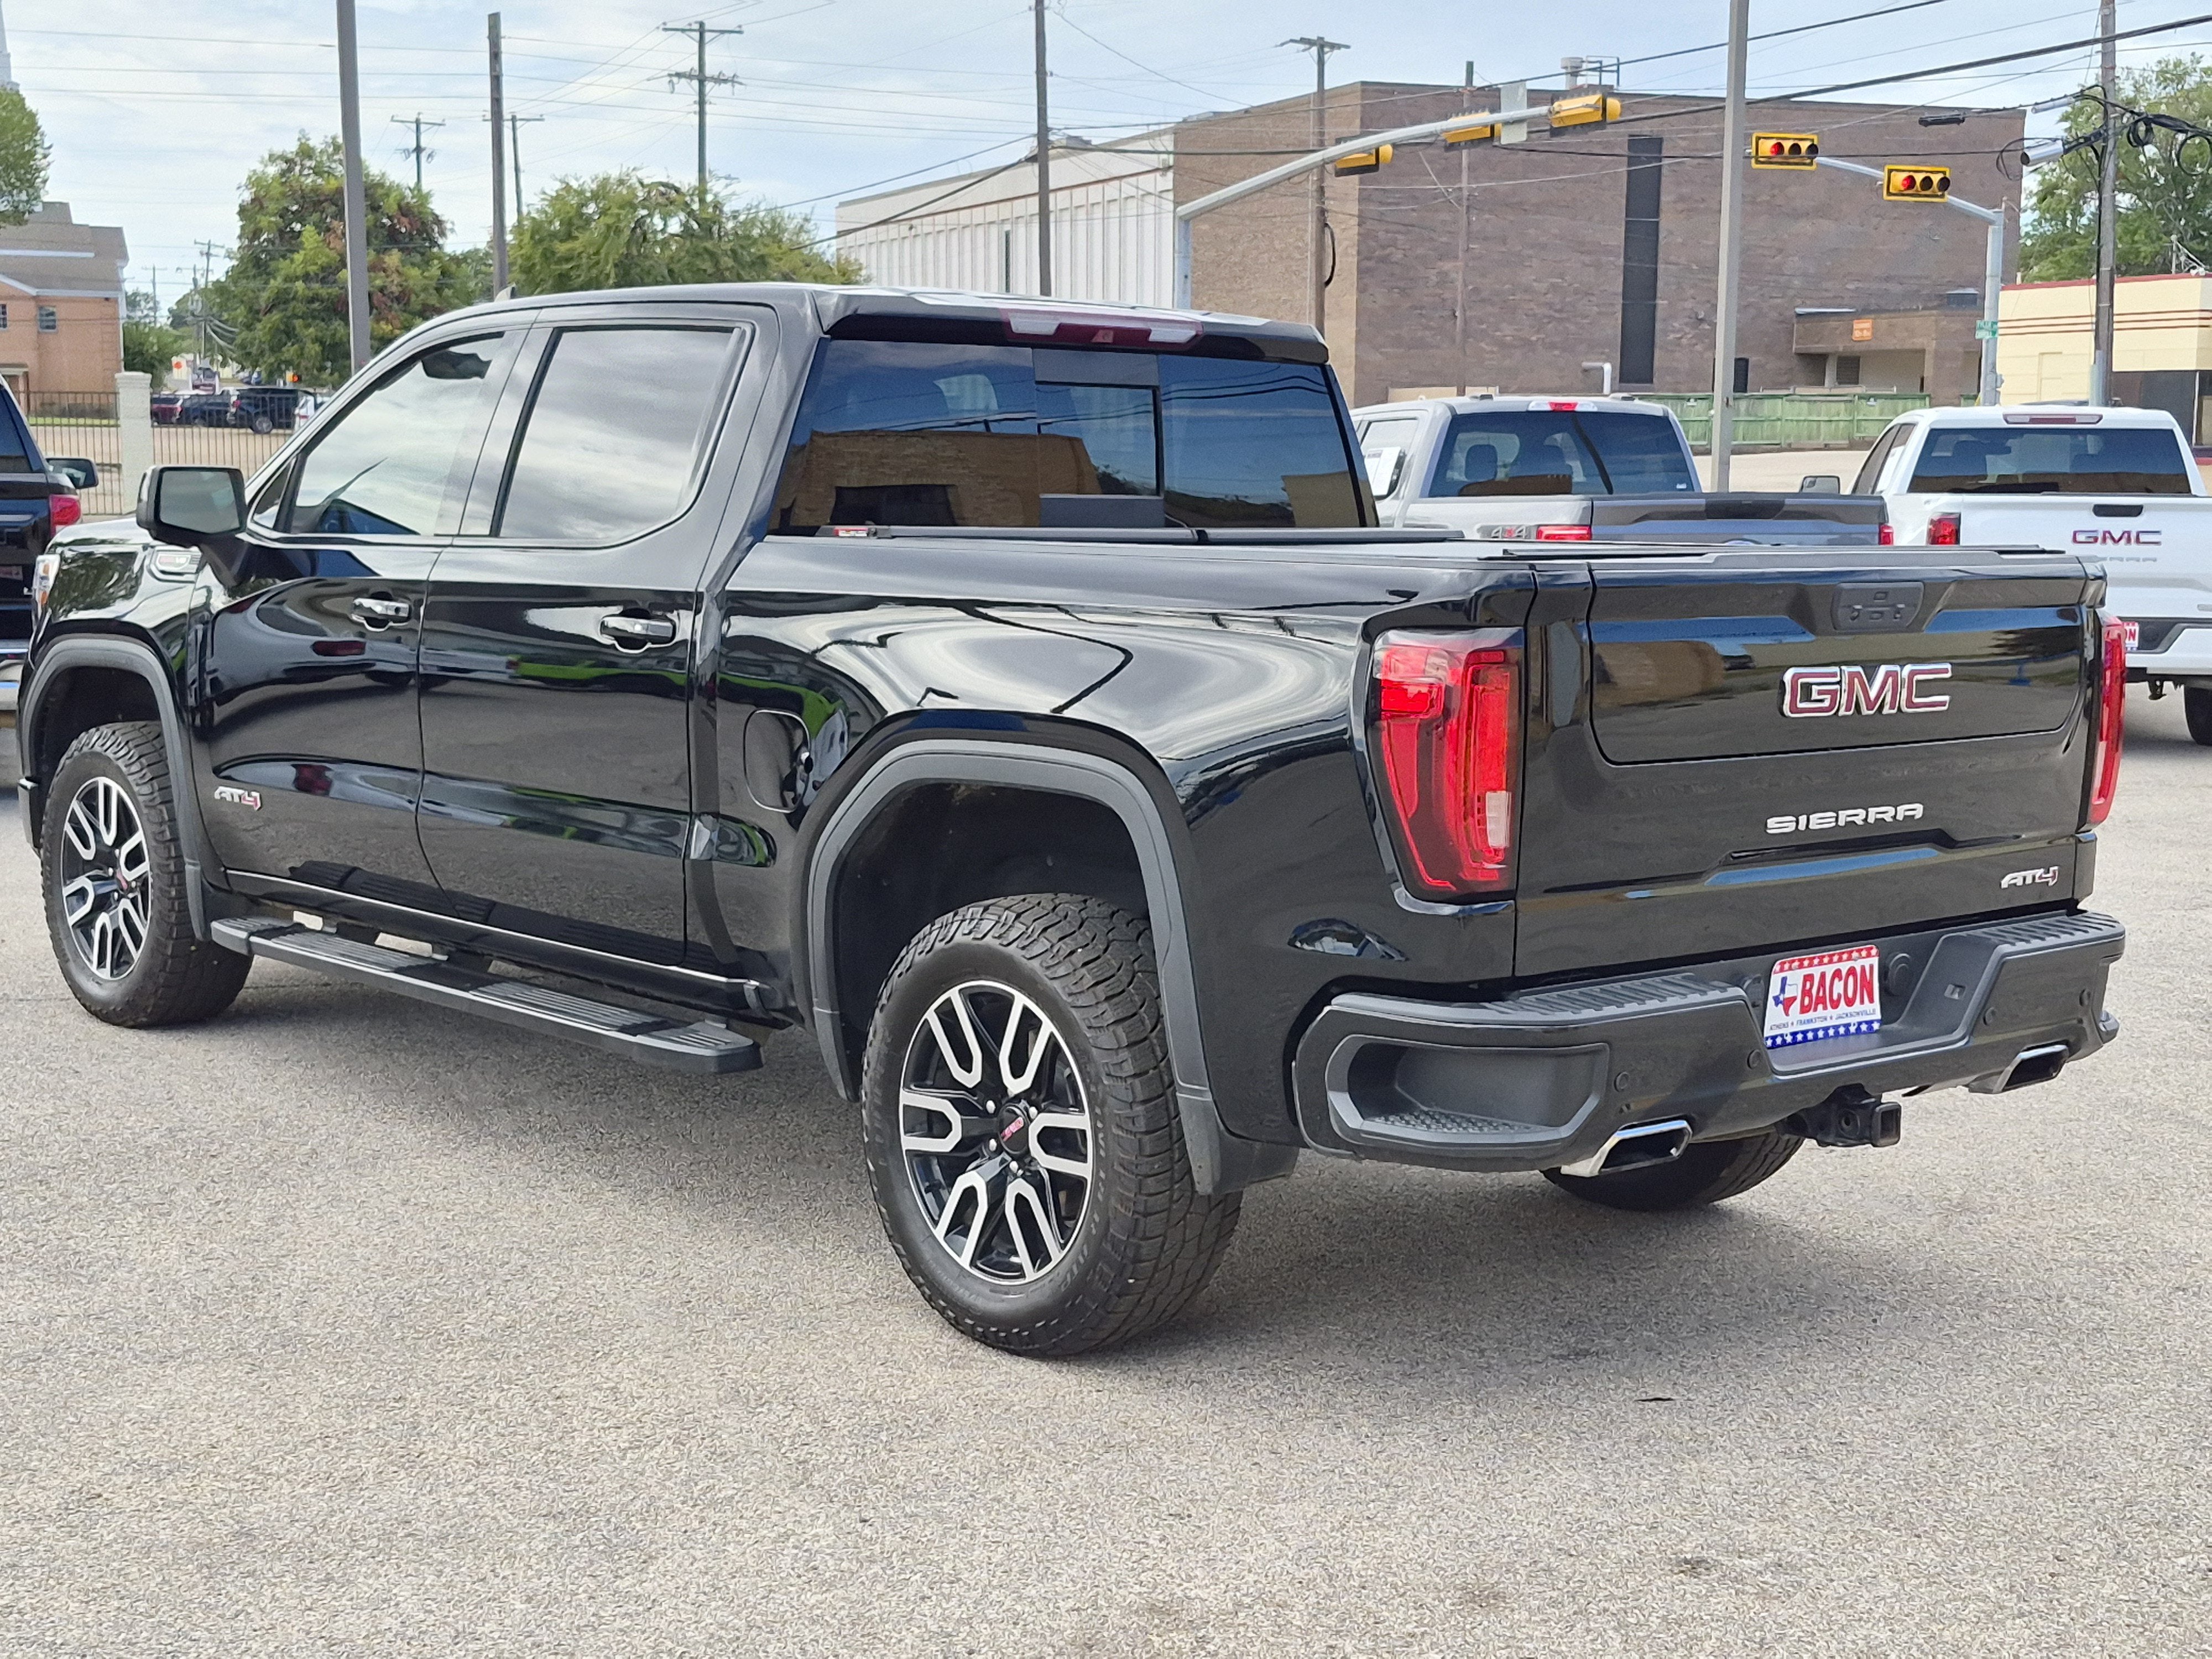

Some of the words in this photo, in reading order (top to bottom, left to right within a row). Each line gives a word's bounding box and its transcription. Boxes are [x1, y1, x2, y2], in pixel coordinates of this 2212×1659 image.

[2072, 530, 2162, 545] GMC
[1782, 662, 1952, 717] GMC
[215, 786, 261, 810] AT4
[1766, 802, 1924, 834] SIERRA
[2001, 865, 2059, 889] AT4
[1799, 963, 1875, 1015] BACON
[1835, 1008, 1876, 1020] JACKSONVILLE
